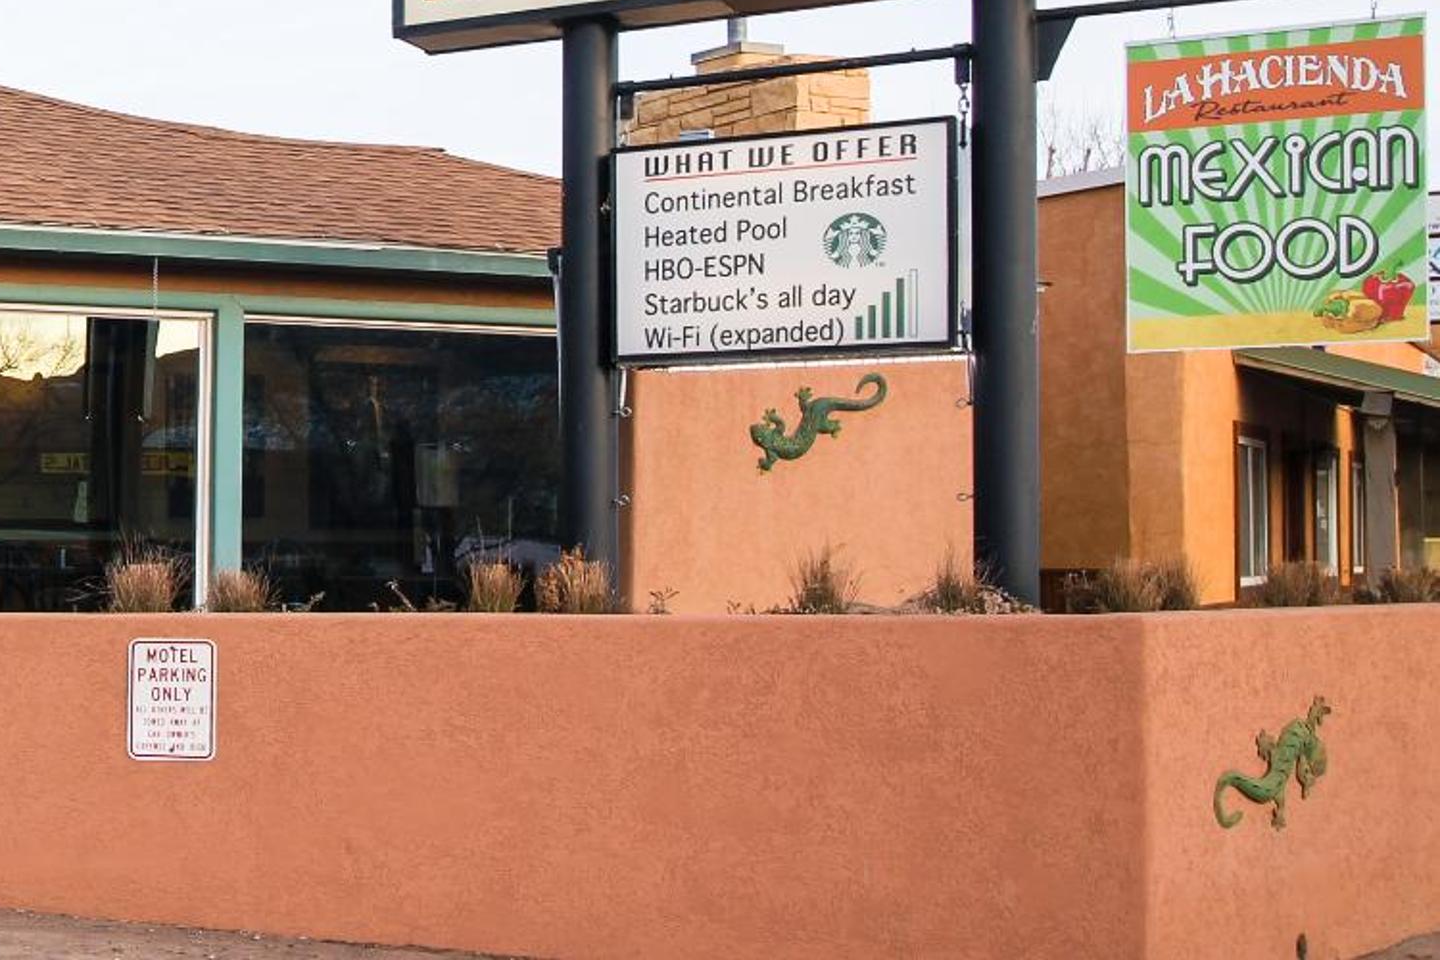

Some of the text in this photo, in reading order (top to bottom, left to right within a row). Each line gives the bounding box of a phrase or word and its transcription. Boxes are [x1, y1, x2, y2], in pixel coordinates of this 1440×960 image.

[1196, 53, 1408, 98] HACIENDA
[1190, 90, 1359, 121] Restaurant
[644, 133, 918, 177] WHAT WE OFFER
[644, 174, 917, 215] Continental Breakfast
[644, 217, 787, 248] Heated Pool
[1175, 215, 1379, 286] FOOD
[644, 253, 765, 282] HBO-ESPN
[644, 284, 856, 316] Starbuck's all day
[645, 317, 845, 349] Wi-Fi (expanded)
[147, 648, 198, 663] MOTEL
[137, 667, 207, 682] PARKING
[151, 686, 191, 701] ONLY
